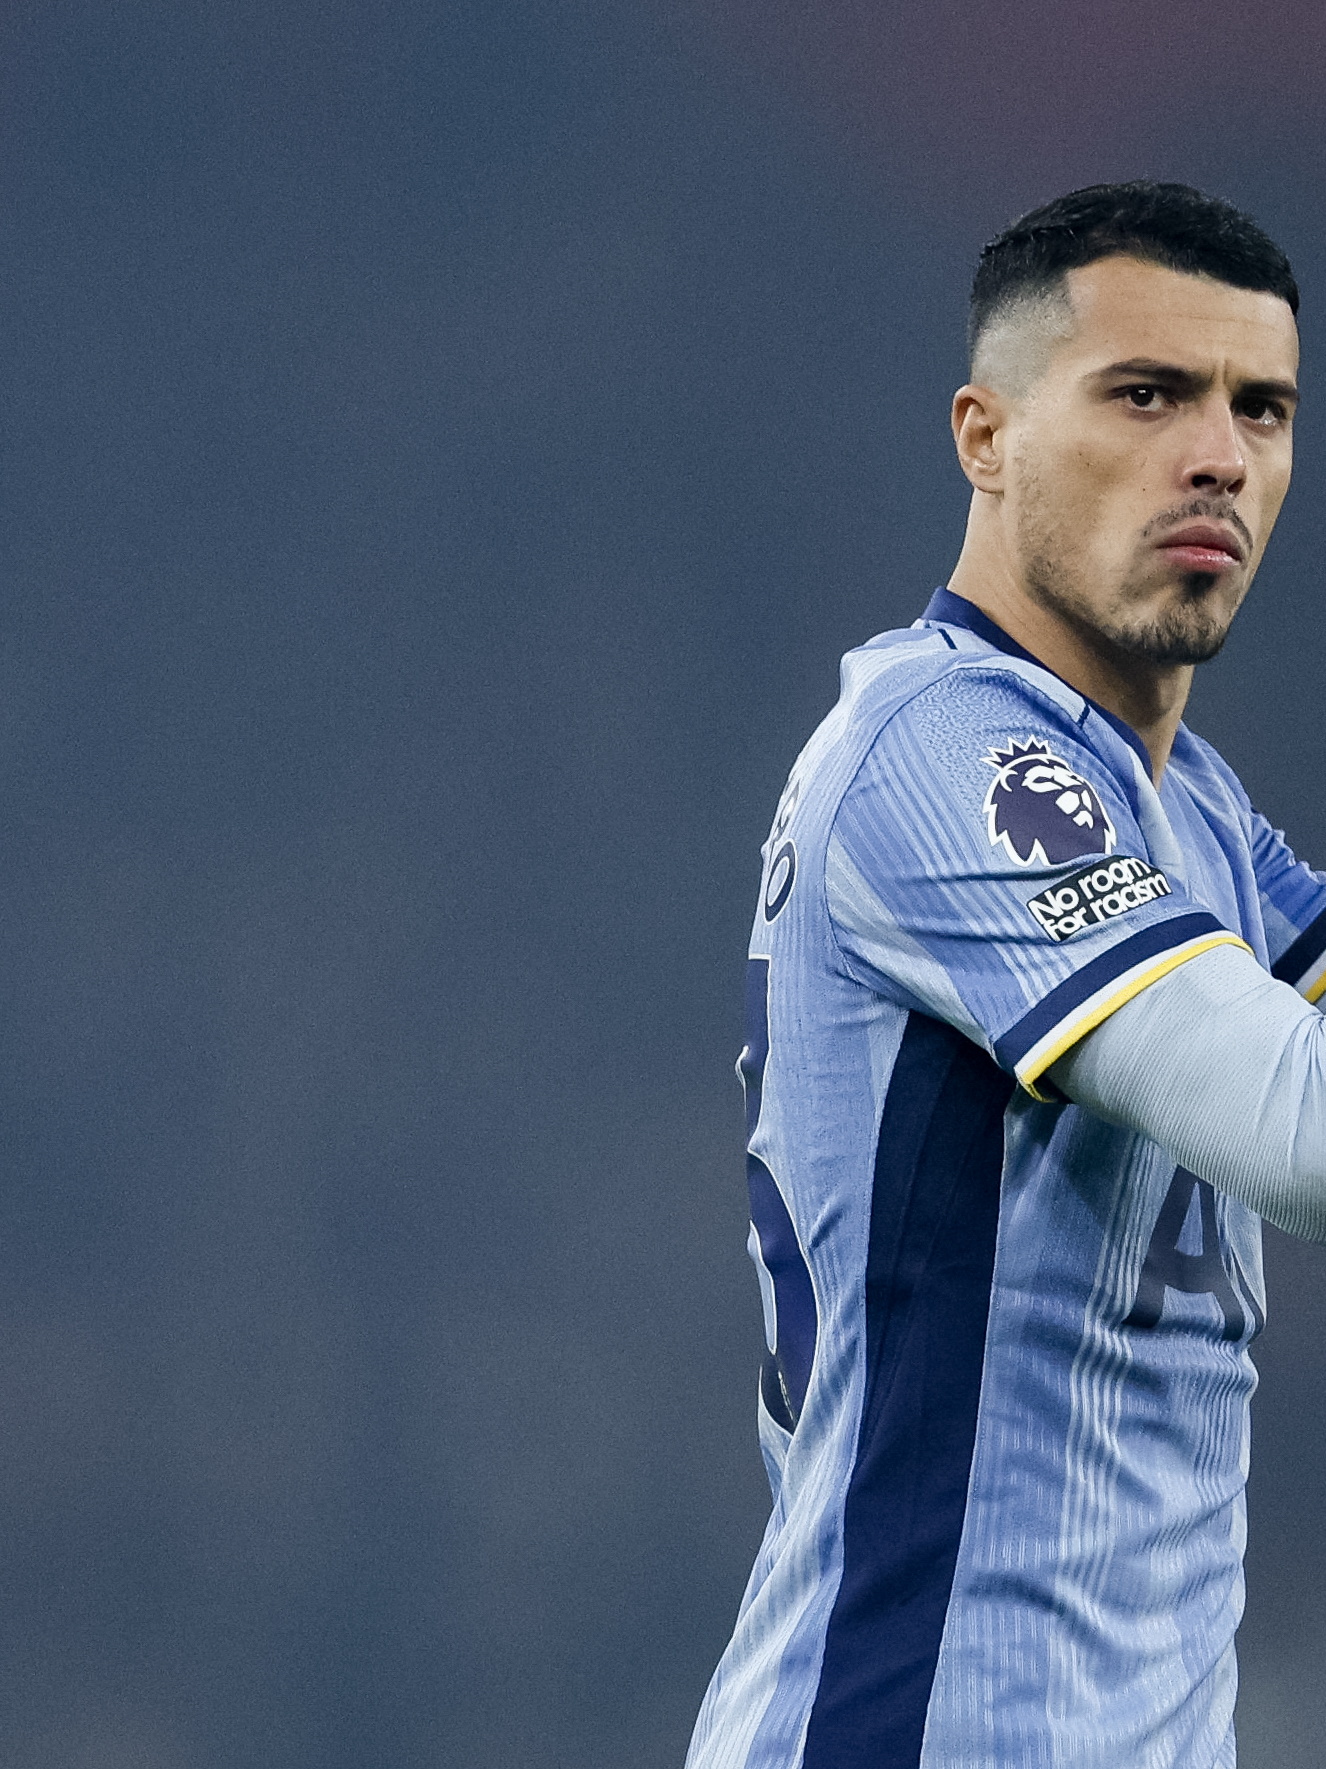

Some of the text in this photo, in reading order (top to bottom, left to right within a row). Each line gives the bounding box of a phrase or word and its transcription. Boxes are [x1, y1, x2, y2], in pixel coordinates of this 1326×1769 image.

[1028, 857, 1151, 925] No room
[1042, 873, 1172, 942] for racism
[1121, 1164, 1266, 1345] A
